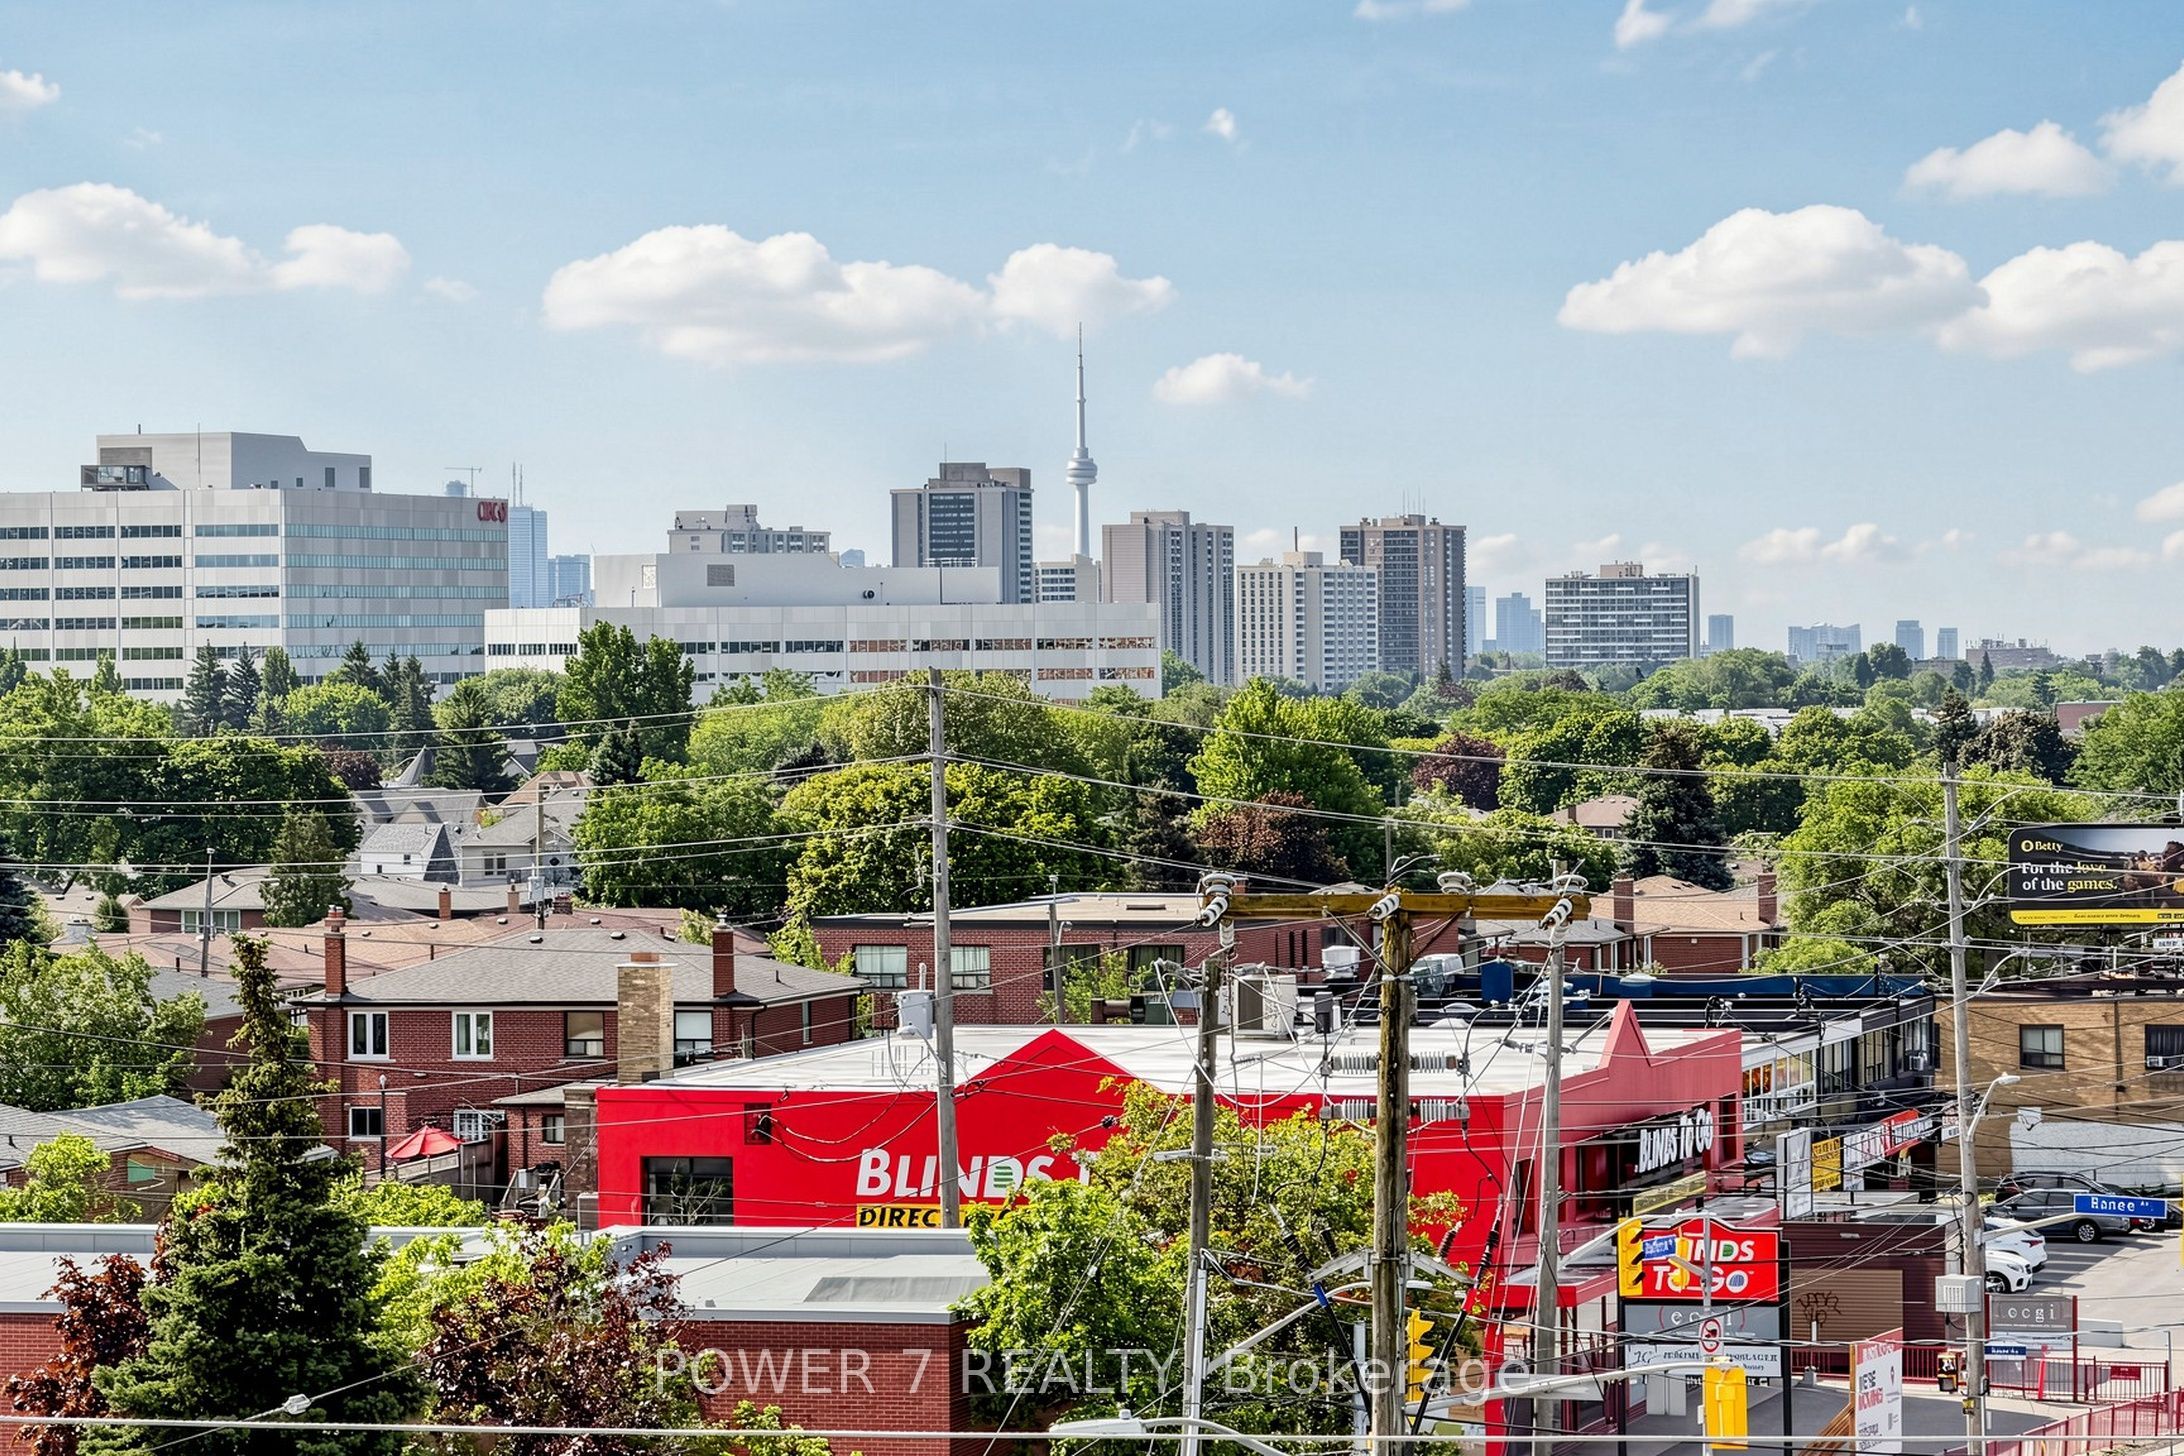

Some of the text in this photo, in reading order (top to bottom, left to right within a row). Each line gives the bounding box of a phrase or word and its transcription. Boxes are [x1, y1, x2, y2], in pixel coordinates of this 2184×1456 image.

[2035, 840, 2063, 853] Betty
[2021, 861, 2044, 874] For
[2050, 861, 2073, 874] the
[2022, 877, 2118, 894] of the games.
[2090, 1196, 2135, 1212] Ranee
[858, 1207, 938, 1228] DIREC
